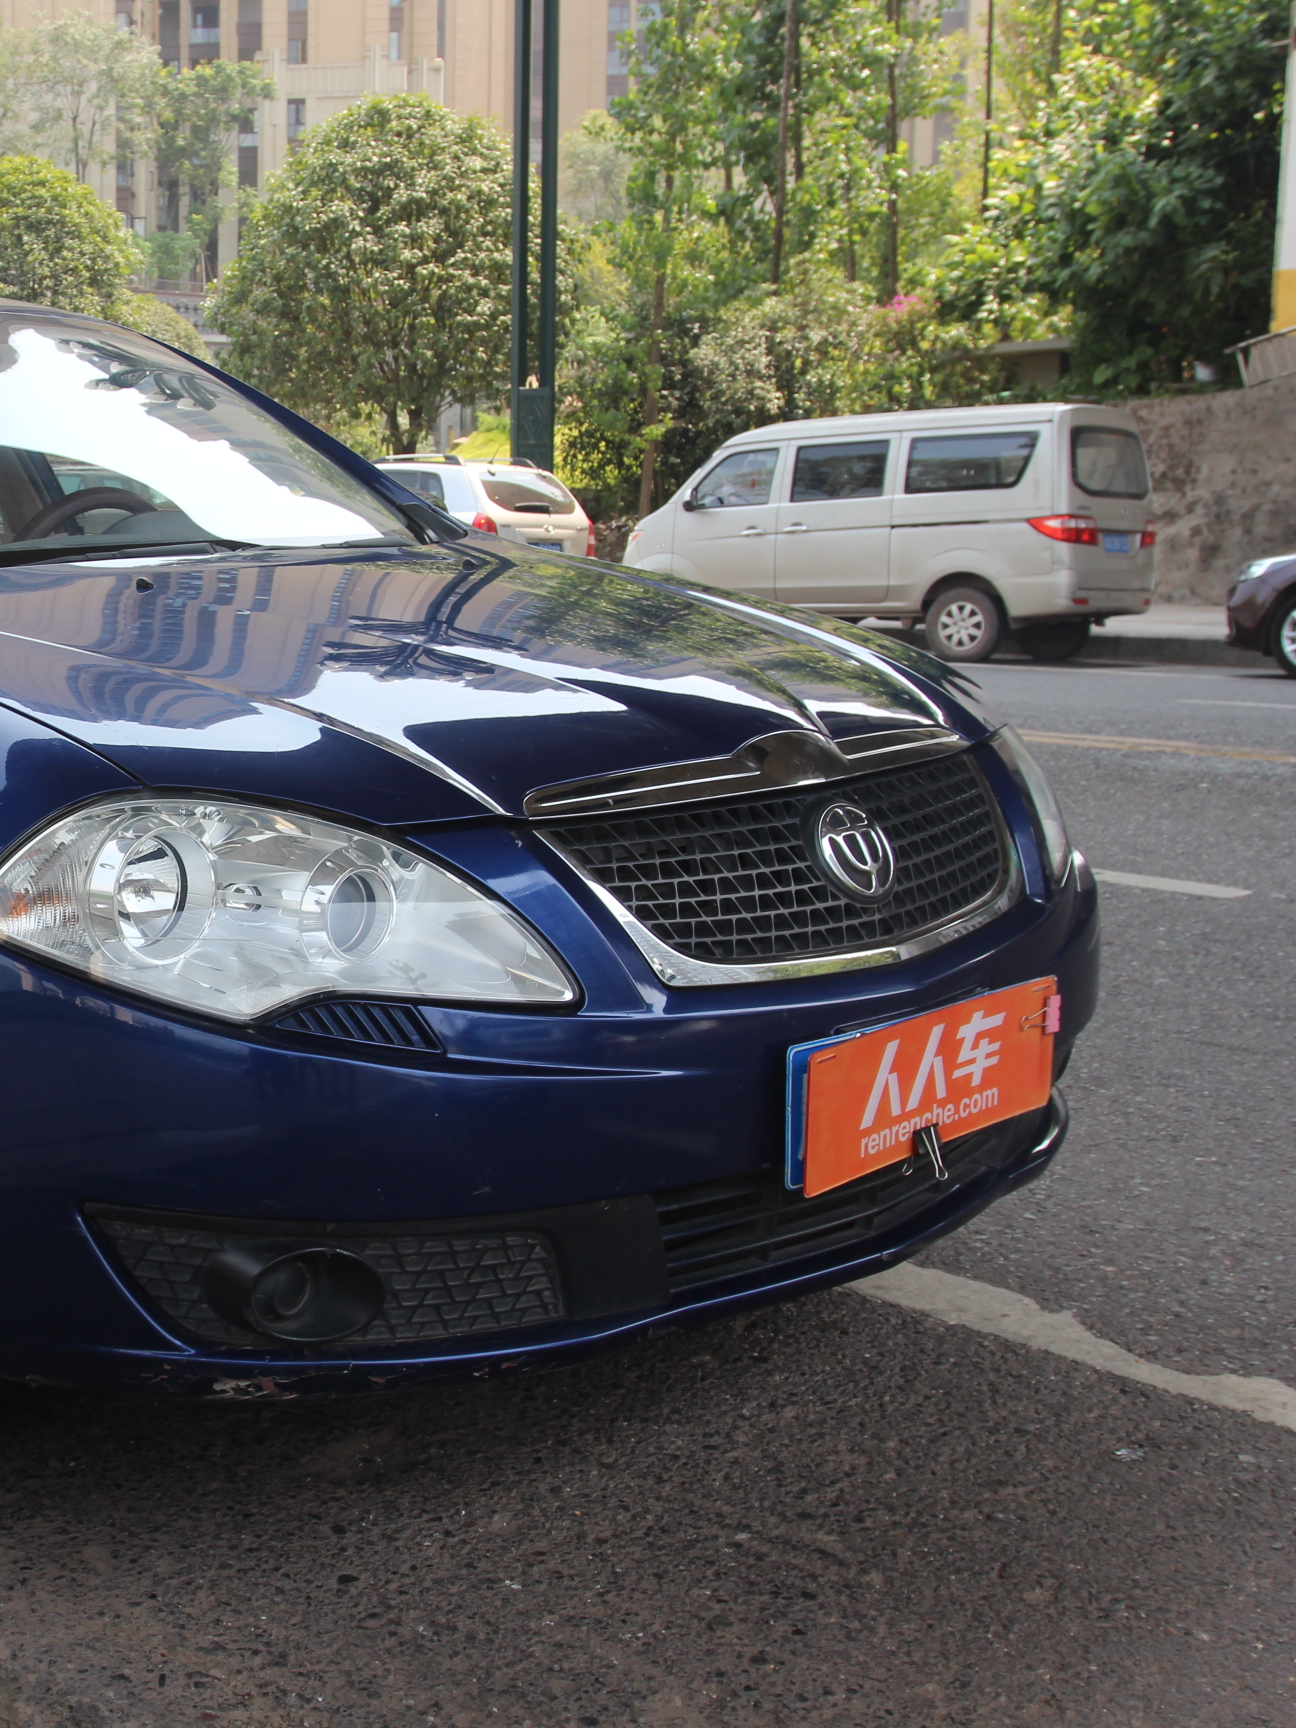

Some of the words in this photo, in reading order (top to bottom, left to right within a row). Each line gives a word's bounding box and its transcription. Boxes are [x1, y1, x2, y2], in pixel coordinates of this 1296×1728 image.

[859, 1010, 1006, 1130] 人人车
[860, 1087, 998, 1158] renrenche.com
